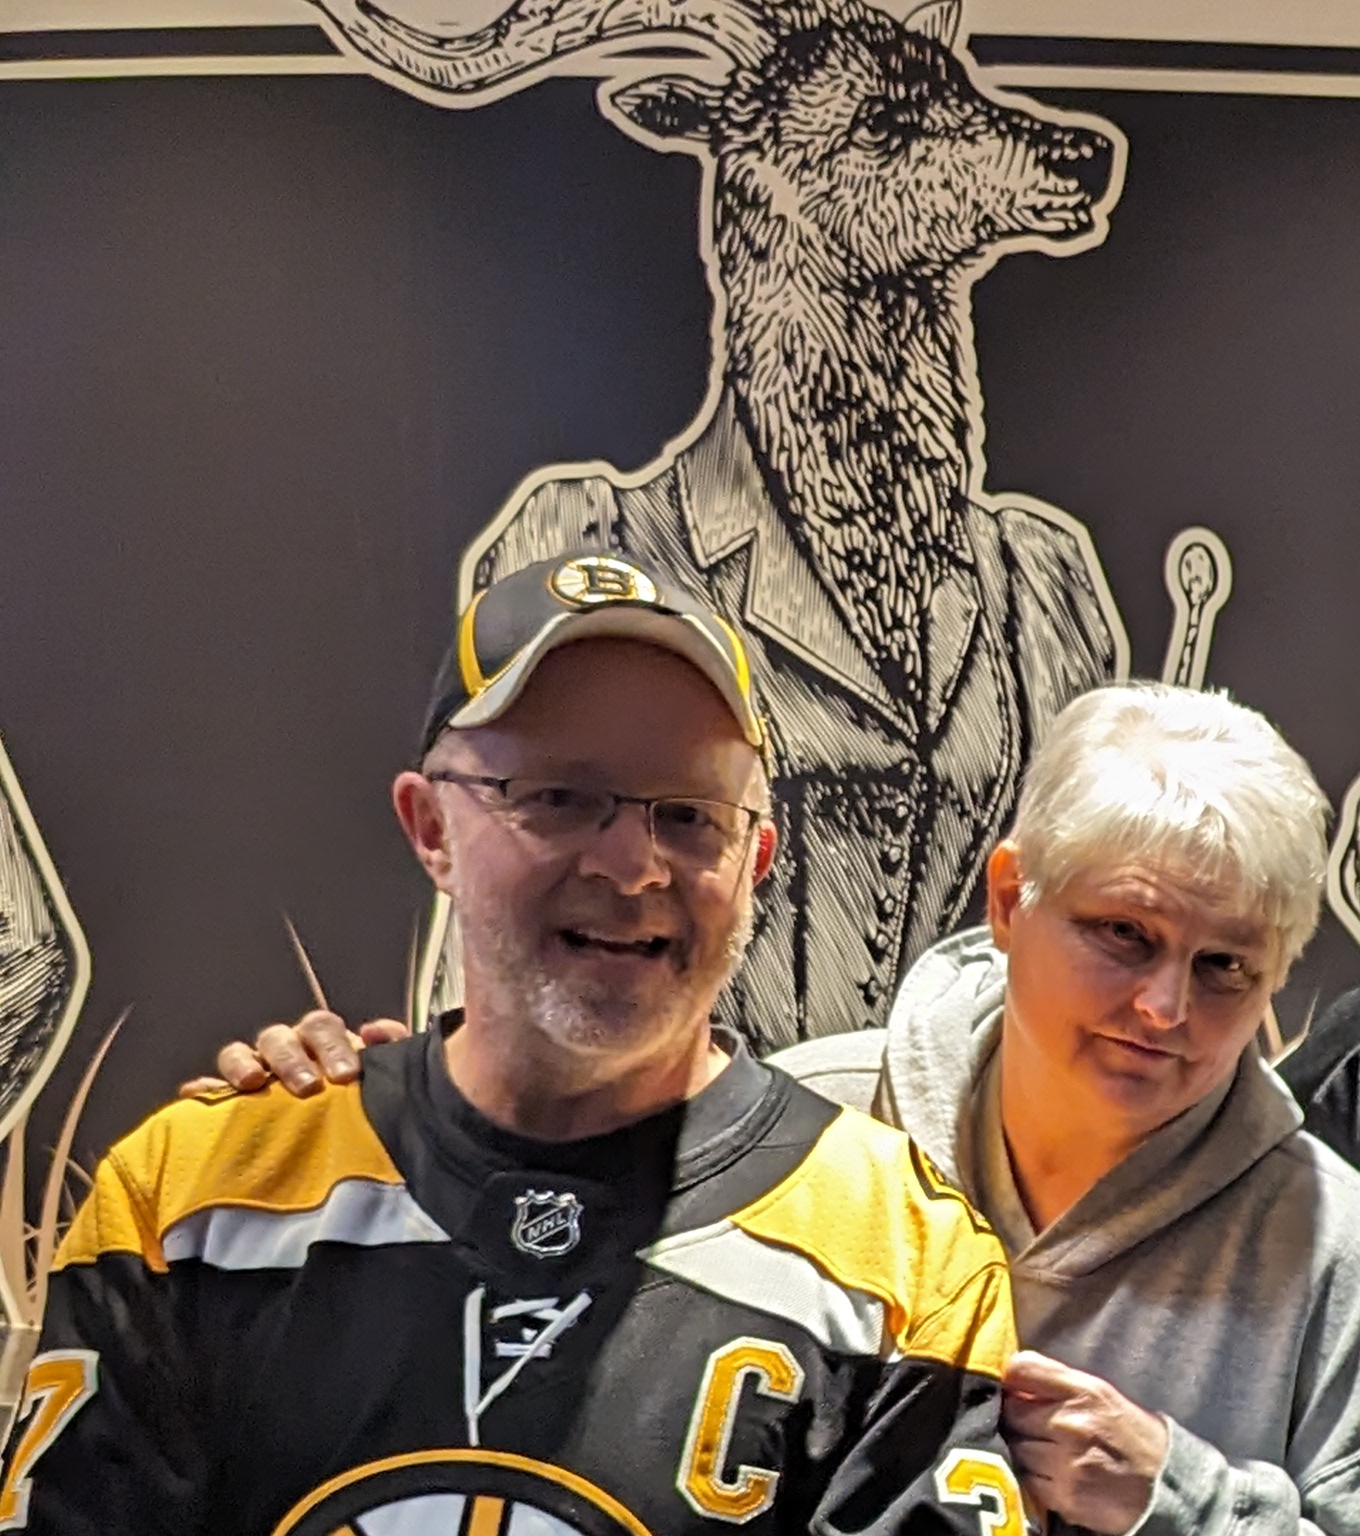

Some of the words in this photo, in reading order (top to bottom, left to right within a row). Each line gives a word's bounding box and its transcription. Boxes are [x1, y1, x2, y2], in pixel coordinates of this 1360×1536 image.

[576, 564, 632, 596] B
[526, 1211, 568, 1242] NHL
[676, 1335, 806, 1526] C
